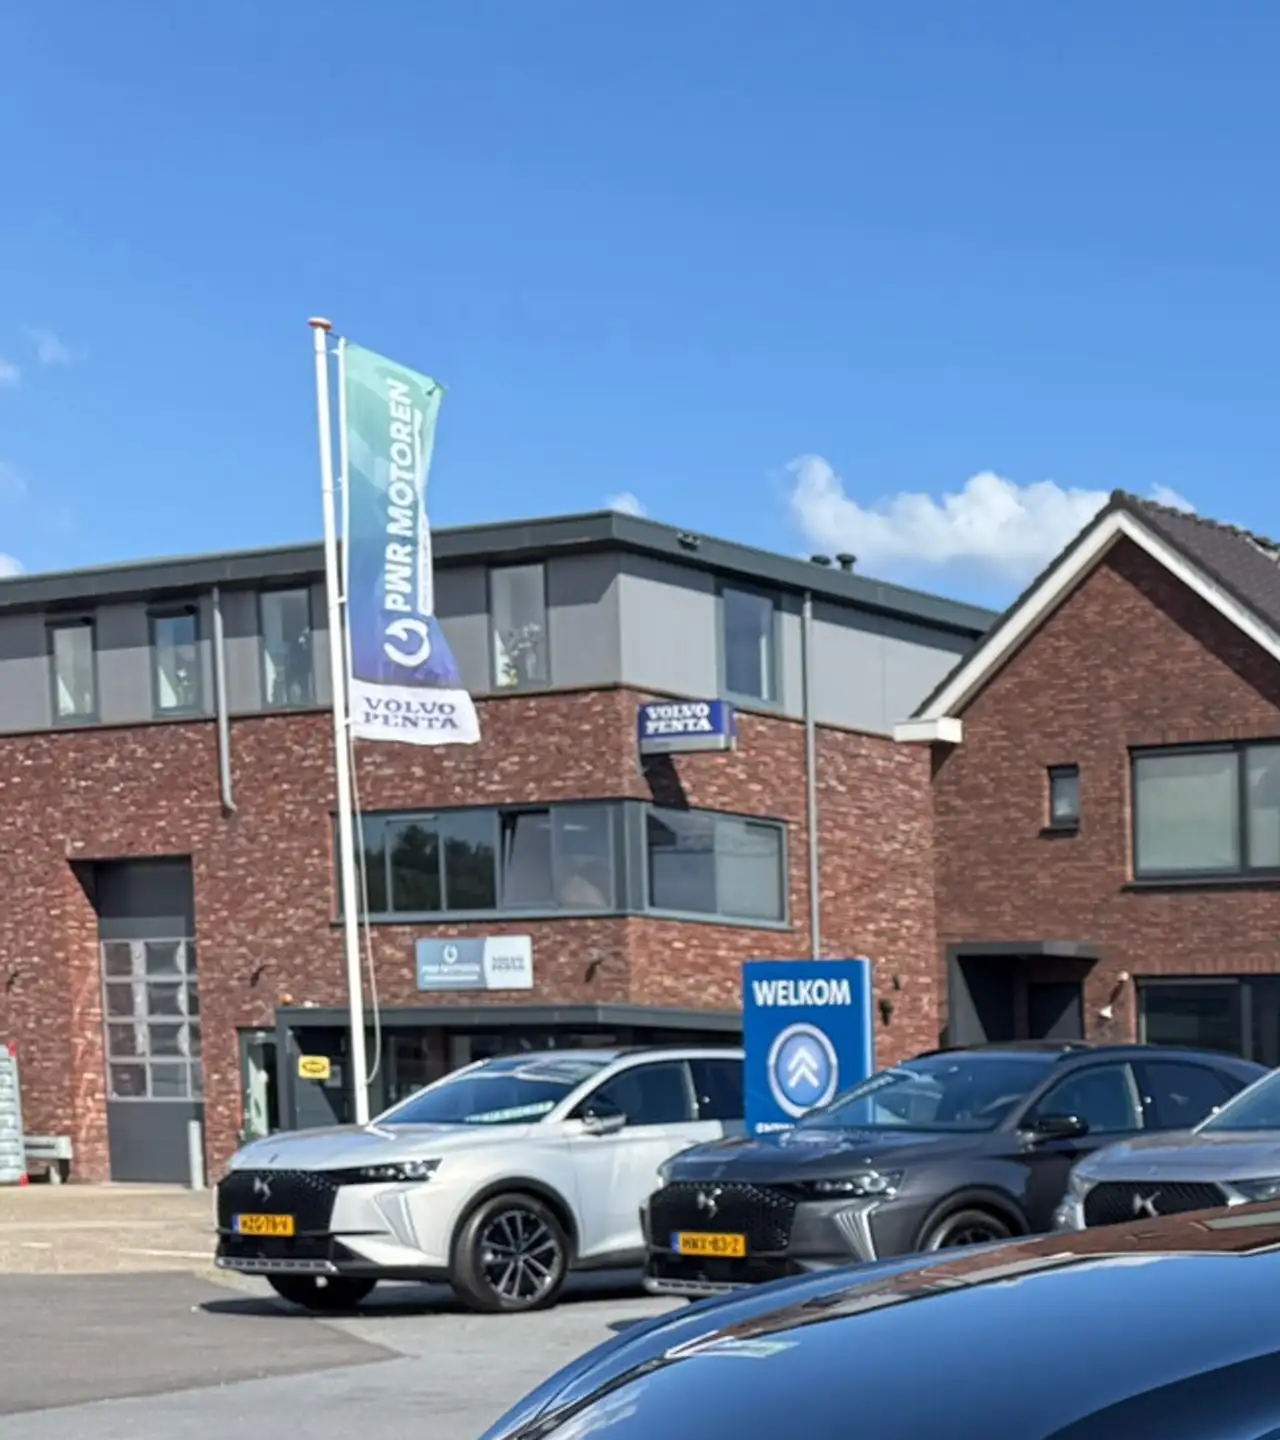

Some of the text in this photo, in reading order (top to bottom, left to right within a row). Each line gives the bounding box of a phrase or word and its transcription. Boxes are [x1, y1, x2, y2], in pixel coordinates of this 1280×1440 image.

[384, 376, 413, 613] PWR MOTOREN
[364, 697, 456, 716] VOLVO
[645, 702, 710, 720] VOLVO
[363, 711, 460, 730] PENTA
[645, 717, 714, 735] PENTA
[752, 978, 852, 1007] WELKOM
